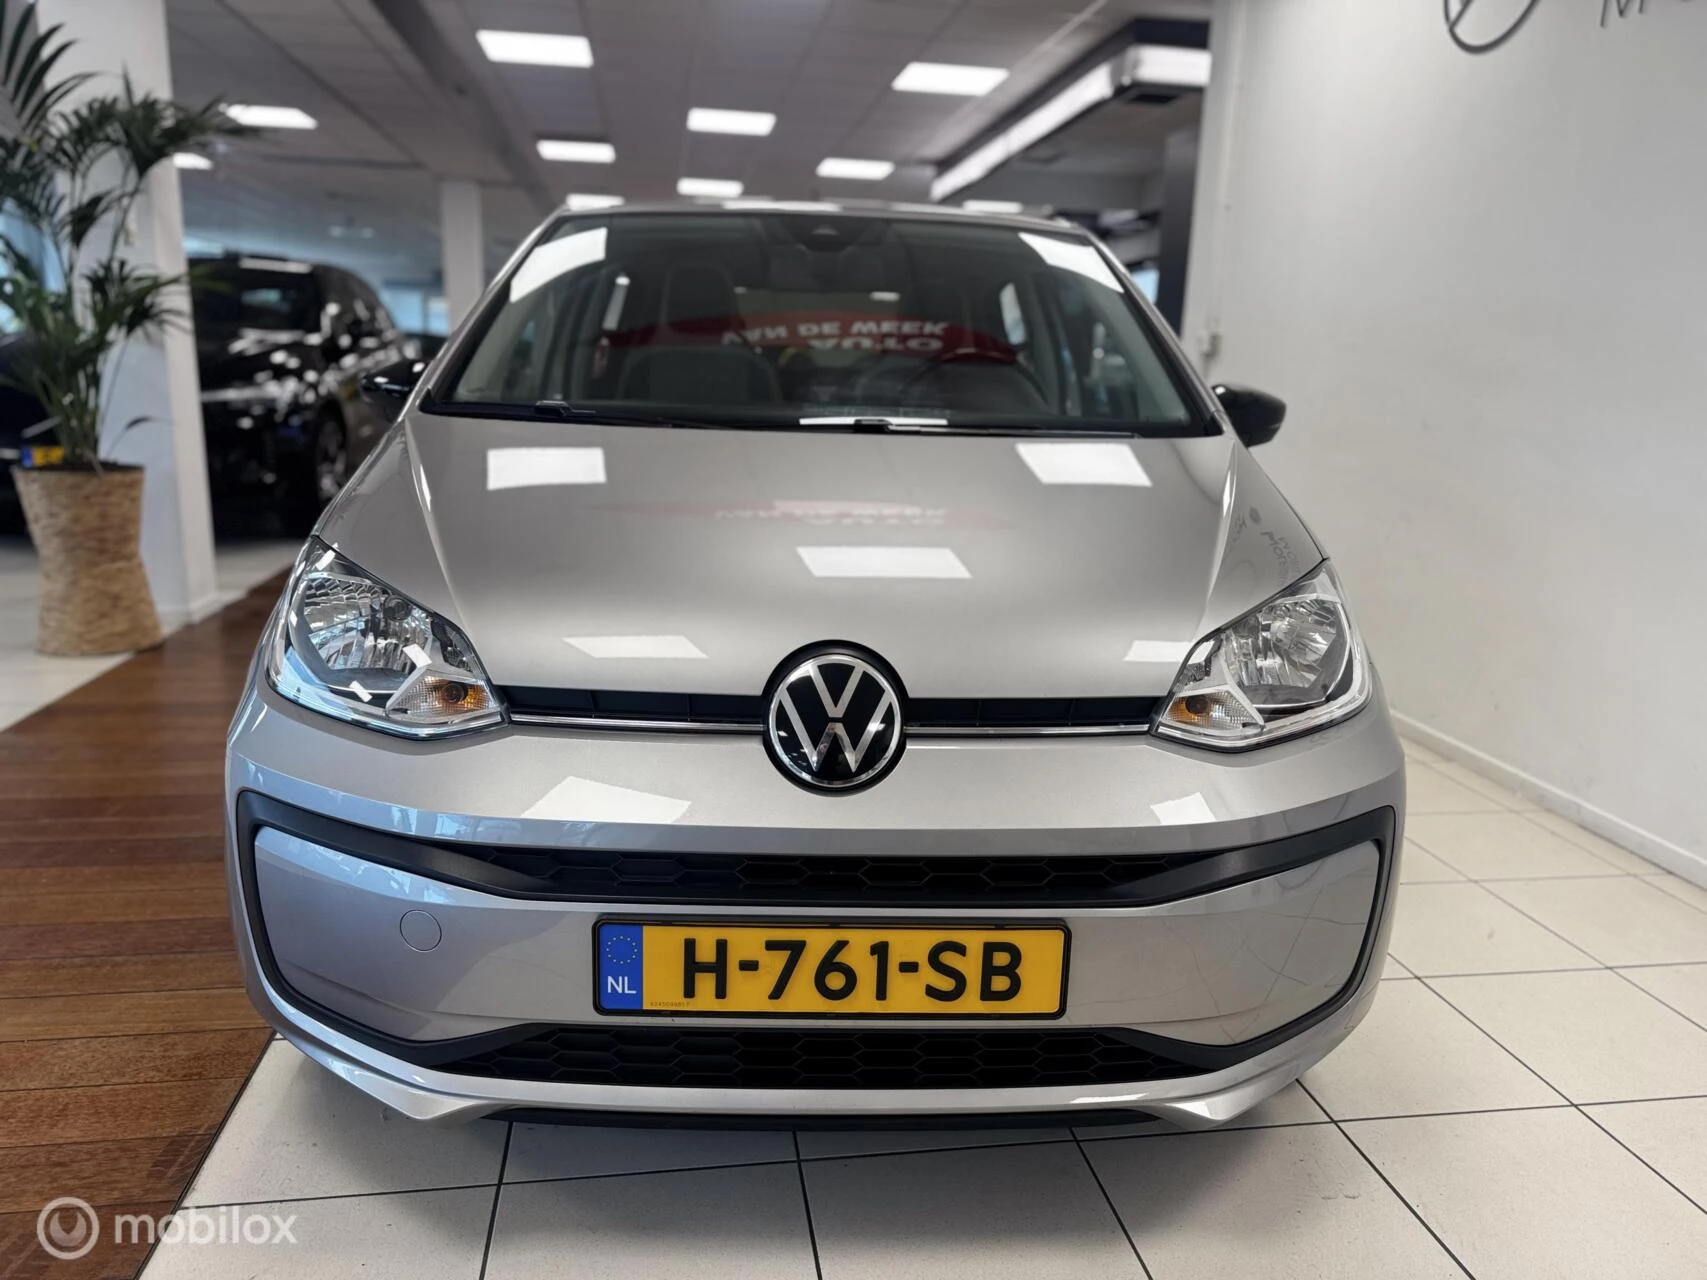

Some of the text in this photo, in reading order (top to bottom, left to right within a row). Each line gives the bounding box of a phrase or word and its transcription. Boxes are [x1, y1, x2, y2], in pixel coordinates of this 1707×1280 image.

[773, 657, 898, 777] VW
[607, 975, 637, 994] NL
[683, 938, 1023, 1001] H-761-SB
